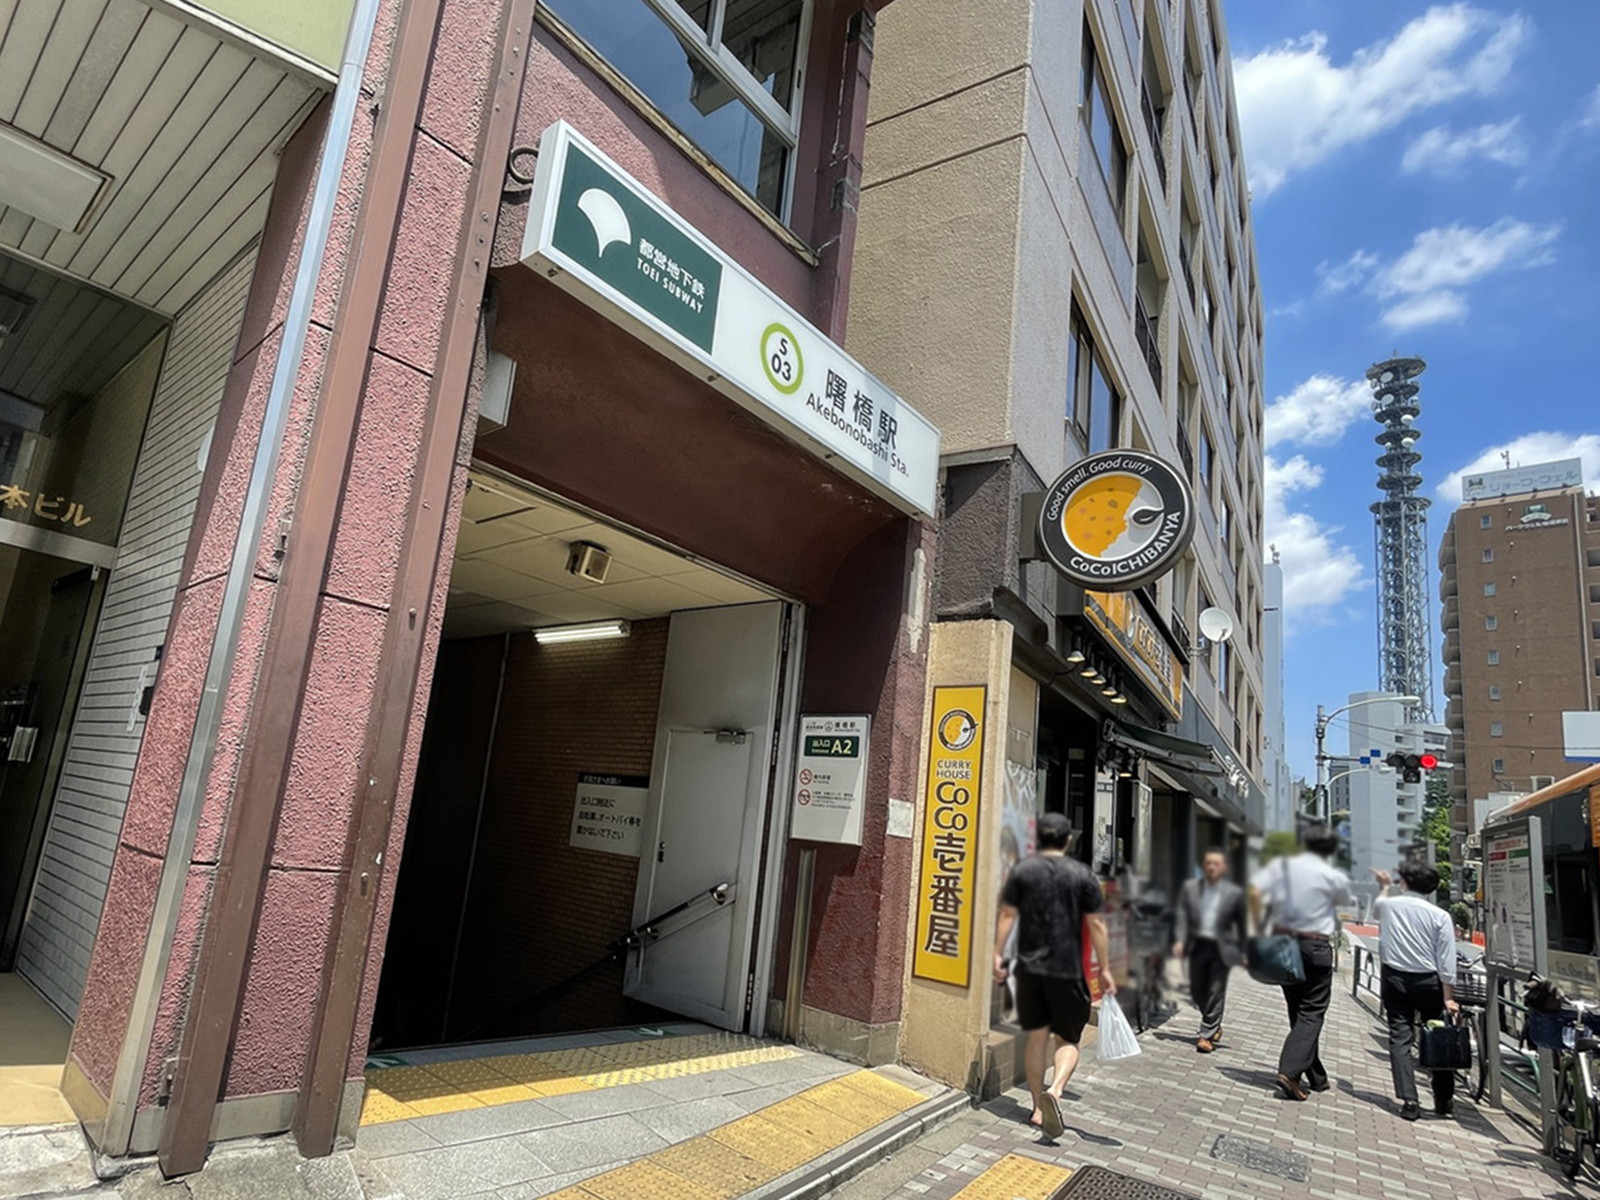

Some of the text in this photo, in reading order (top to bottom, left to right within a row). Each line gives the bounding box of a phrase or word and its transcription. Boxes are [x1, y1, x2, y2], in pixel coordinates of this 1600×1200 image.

[637, 257, 703, 314] TOEI SUBWAY
[639, 238, 705, 300] 都営地下鉄
[771, 354, 791, 381] 03
[779, 338, 788, 355] S
[806, 392, 910, 478] Akebonobashi Sta.
[825, 368, 898, 450] 曙橋駅
[1046, 456, 1153, 521] Good smell. Good curry
[1070, 511, 1181, 576] CoCoICHIBANYA
[831, 739, 852, 754] A2
[936, 770, 970, 780] HOUSE
[937, 760, 971, 769] CURRY
